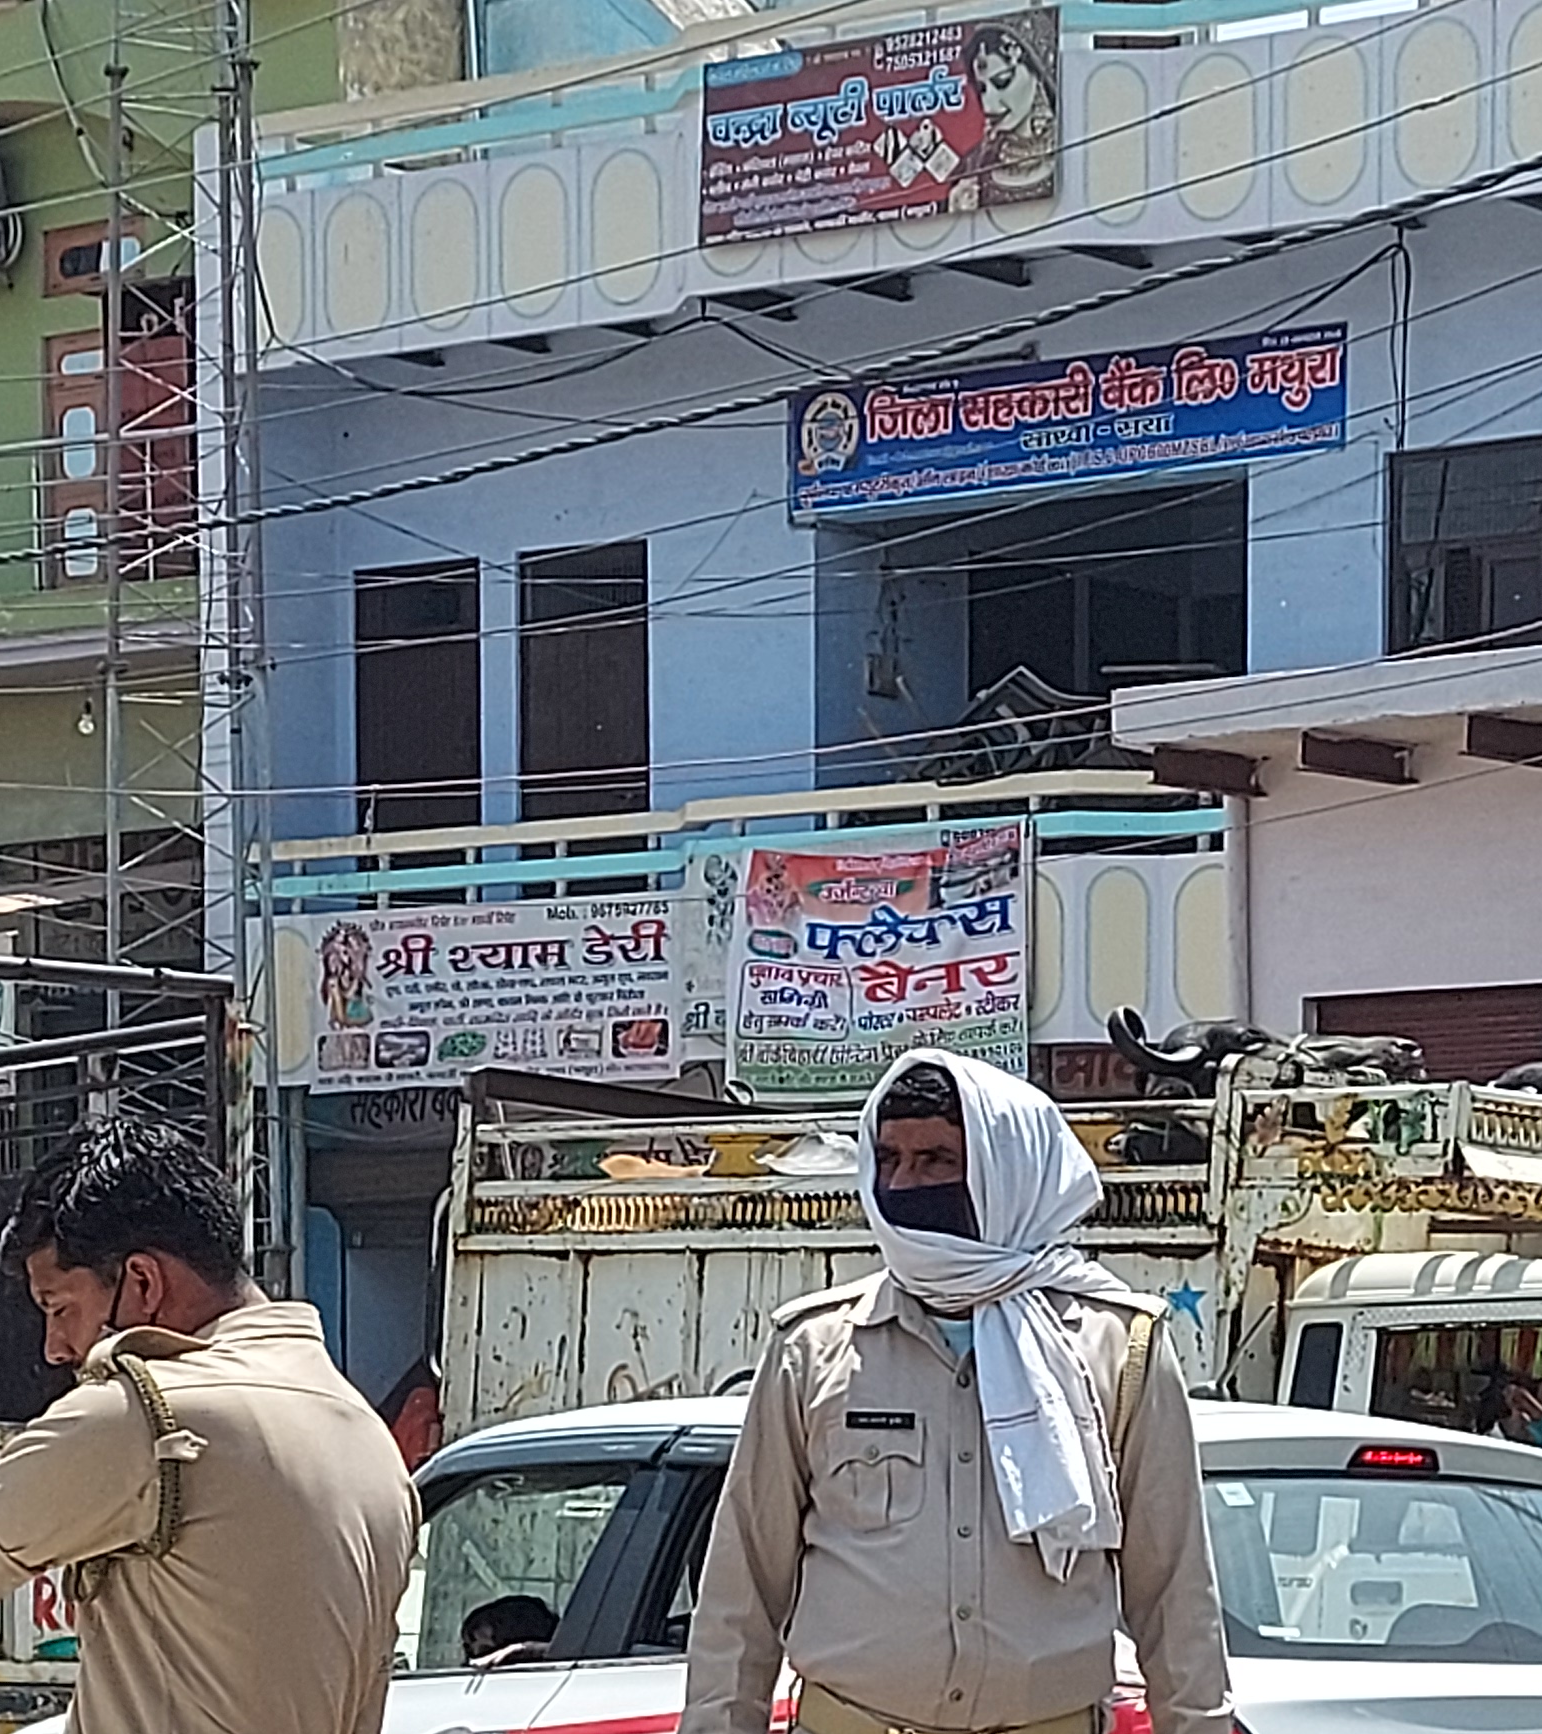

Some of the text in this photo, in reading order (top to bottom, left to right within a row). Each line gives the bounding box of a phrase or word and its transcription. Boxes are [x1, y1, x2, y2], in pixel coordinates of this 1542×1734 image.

[872, 64, 967, 119] पार्लर
[864, 386, 956, 443] जिला
[958, 361, 1095, 431] सहकारी
[1099, 354, 1167, 412] बैंक
[1246, 343, 1344, 411] मथुरा
[375, 919, 672, 980] श्री श्याम डेरी
[852, 951, 1021, 1004] बैनर
